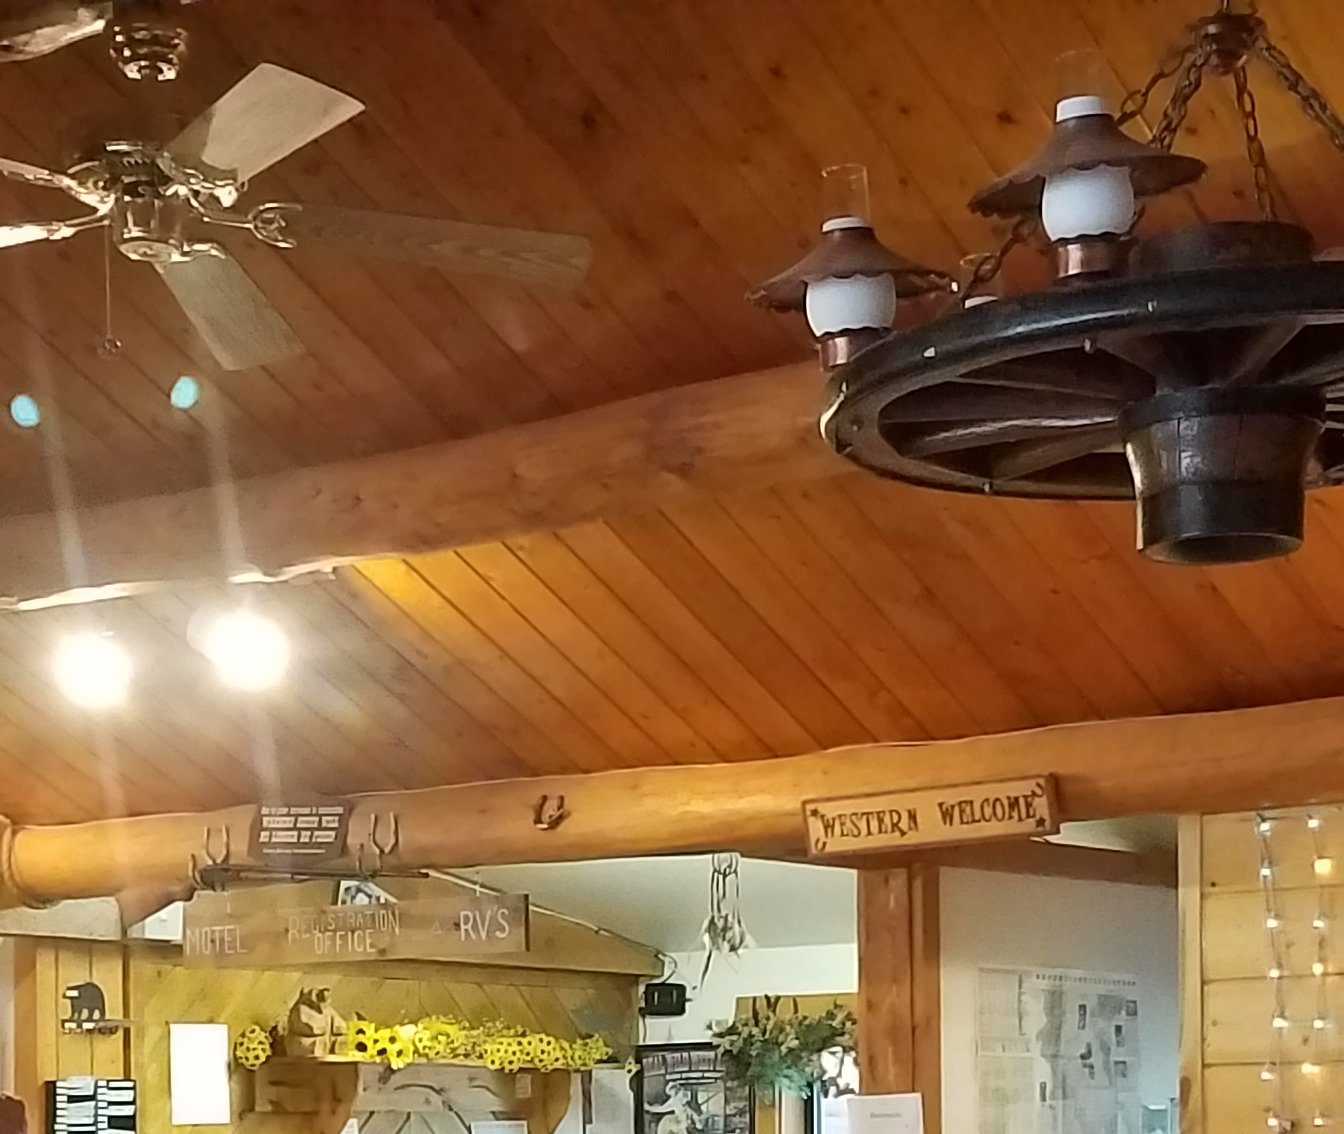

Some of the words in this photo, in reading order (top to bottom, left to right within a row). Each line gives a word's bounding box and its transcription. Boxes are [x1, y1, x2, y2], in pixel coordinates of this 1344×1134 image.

[820, 808, 919, 839] WESTERN
[937, 794, 1038, 828] WELCOME
[186, 924, 248, 956] MOTEL
[288, 905, 401, 945] REGISTRATION
[459, 905, 511, 942] RV'S
[313, 929, 377, 956] OFFICE
